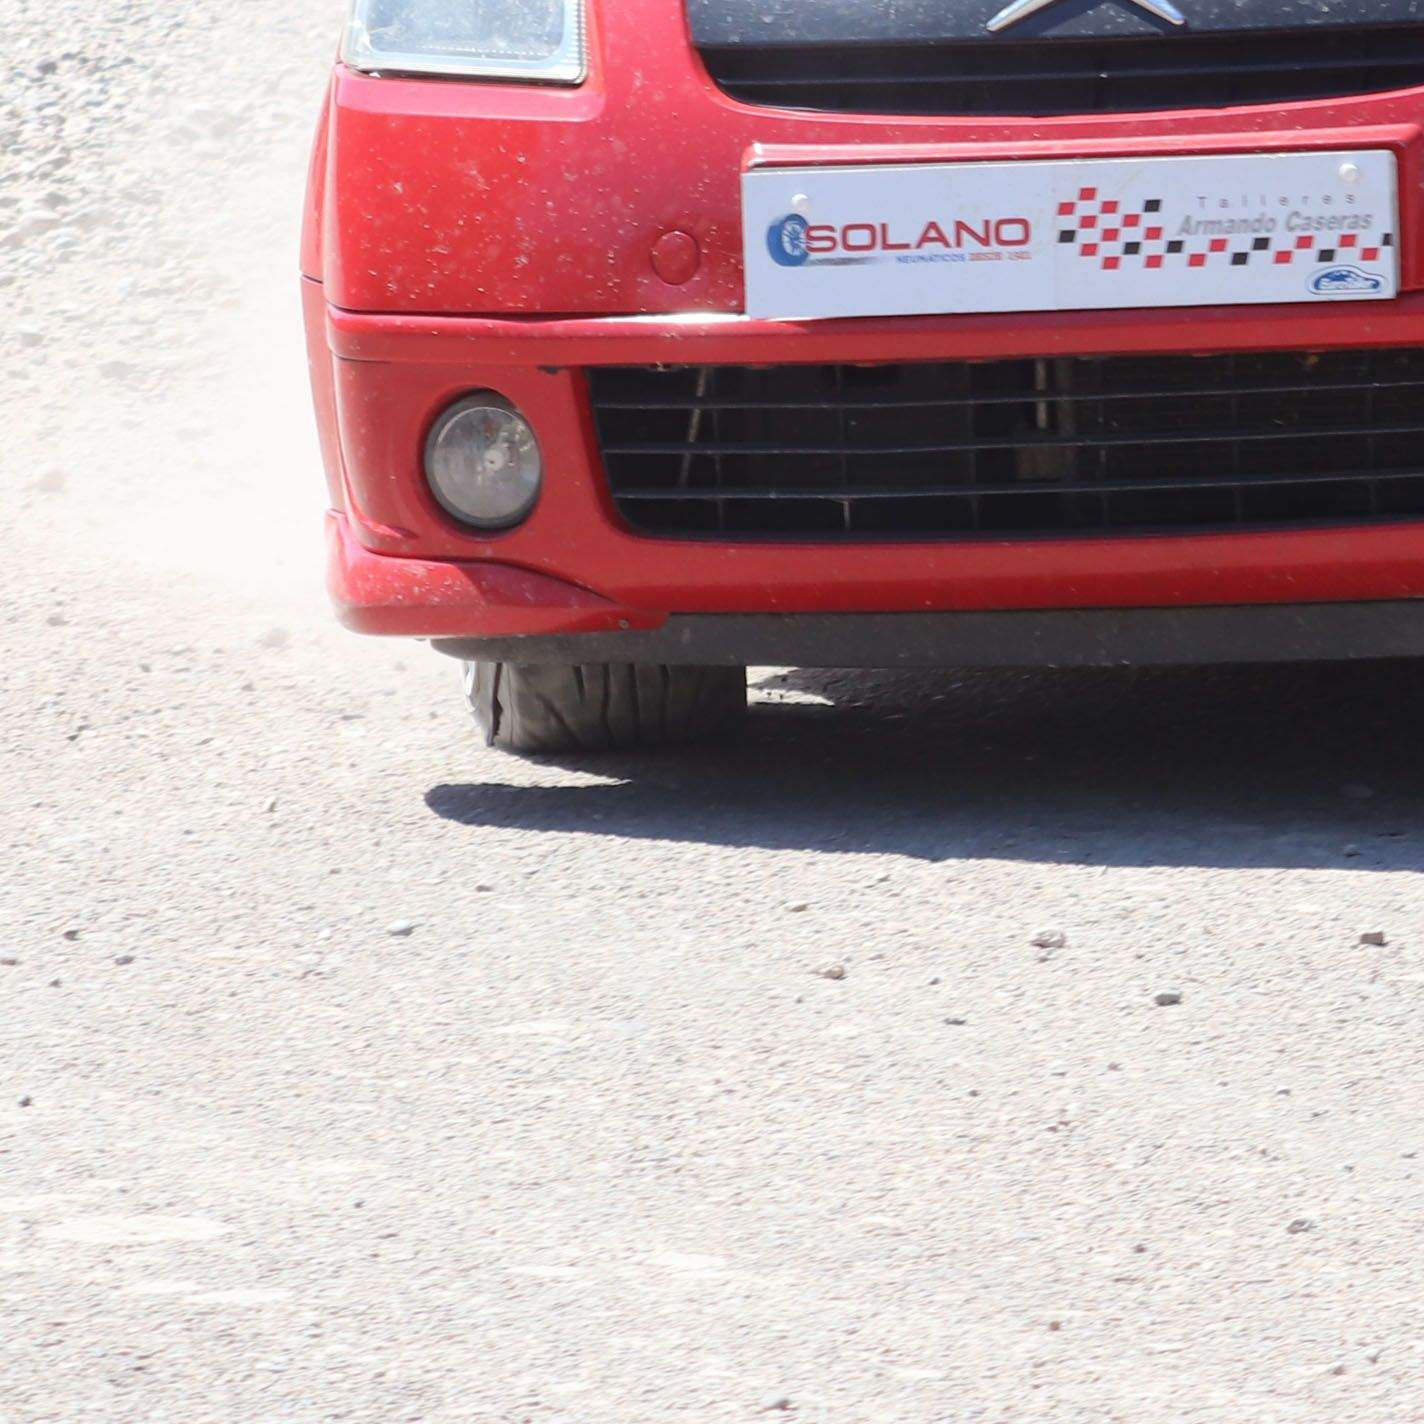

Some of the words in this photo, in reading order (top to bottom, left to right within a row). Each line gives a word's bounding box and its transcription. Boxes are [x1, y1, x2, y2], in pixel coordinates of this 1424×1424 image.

[1197, 194, 1356, 209] Talleres
[804, 218, 1032, 253] SOLANO
[1178, 213, 1277, 236] Armando
[1285, 210, 1374, 232] Caseras
